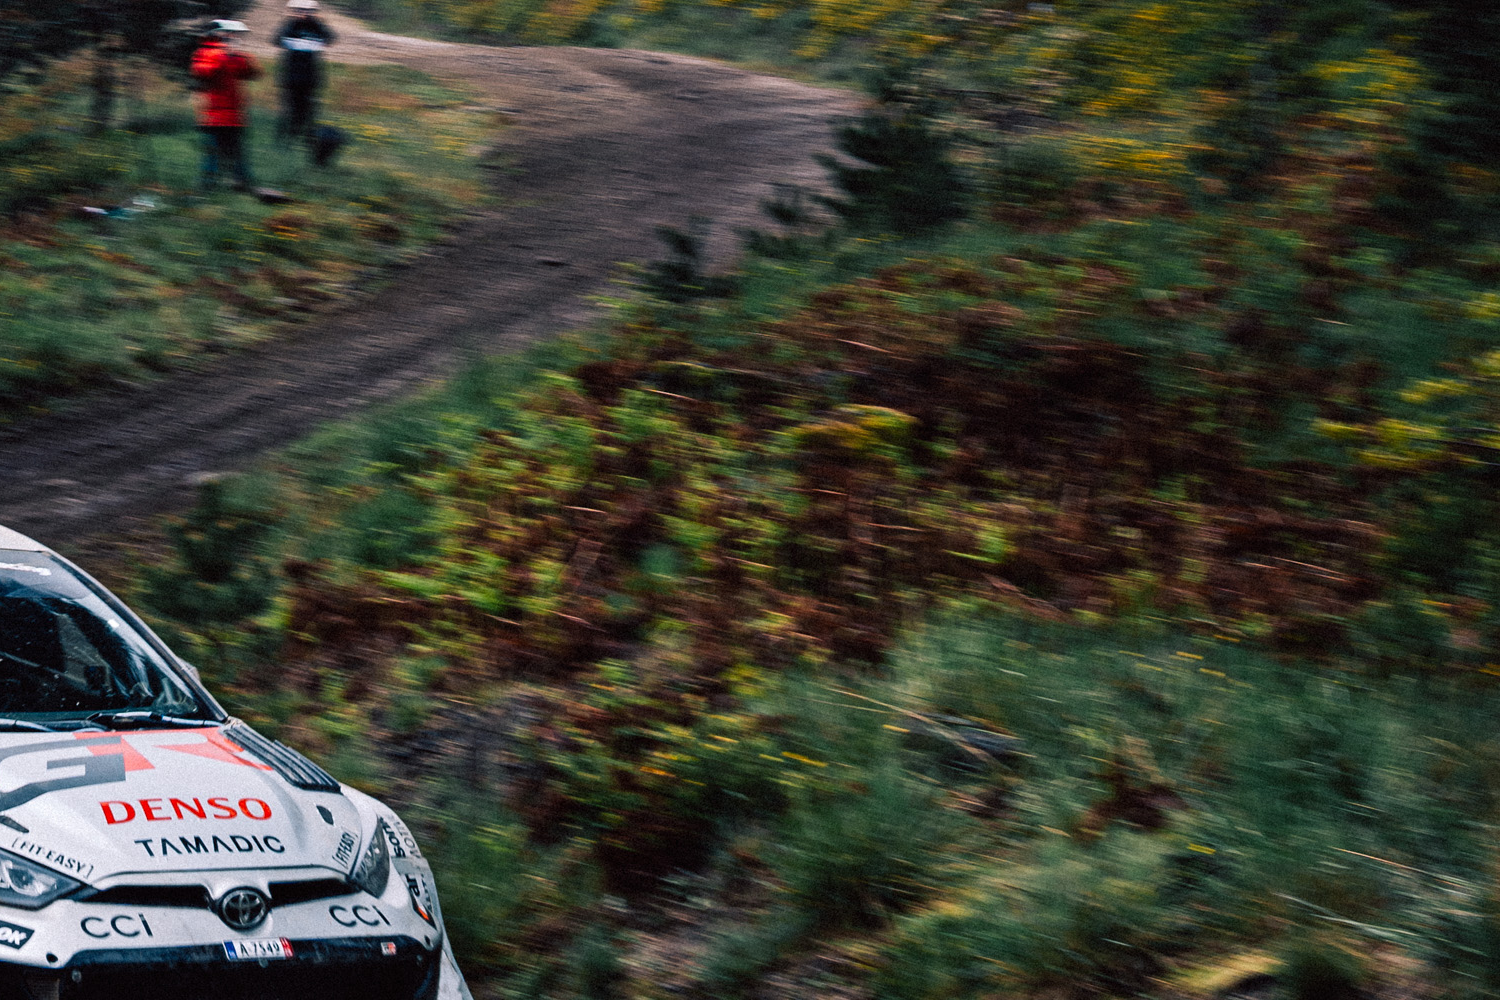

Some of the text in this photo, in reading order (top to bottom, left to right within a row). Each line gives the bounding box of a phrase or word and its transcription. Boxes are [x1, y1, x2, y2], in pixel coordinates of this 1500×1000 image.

[99, 797, 272, 825] DENSO
[134, 835, 285, 857] TAMADIC
[80, 913, 154, 938] CCI
[329, 905, 391, 927] CCI
